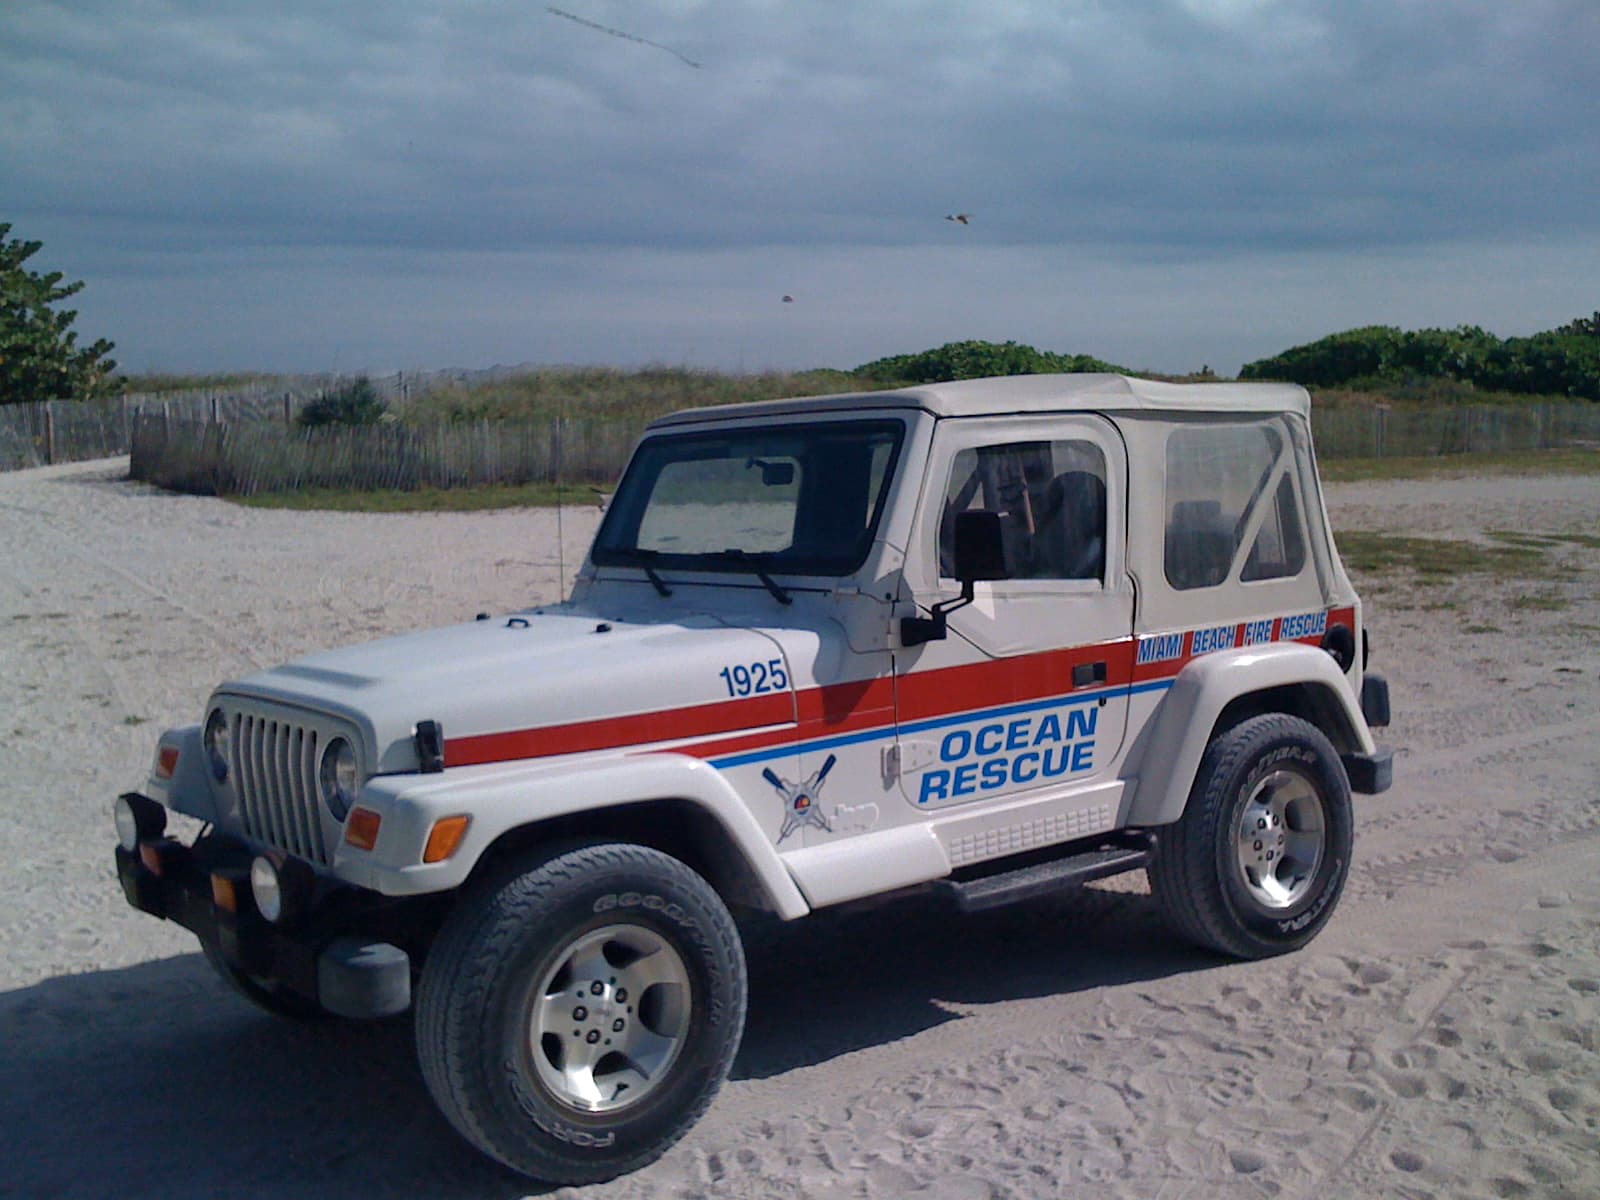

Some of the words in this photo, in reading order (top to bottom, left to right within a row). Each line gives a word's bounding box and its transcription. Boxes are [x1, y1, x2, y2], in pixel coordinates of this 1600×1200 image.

[1138, 634, 1184, 664] MIAMI
[1192, 626, 1235, 655] BEACH
[1244, 619, 1273, 646] FIRE
[1281, 612, 1327, 640] RESCUE
[720, 659, 787, 697] 1925
[940, 707, 1098, 762] OCEAN
[918, 741, 1095, 803] RESCUE
